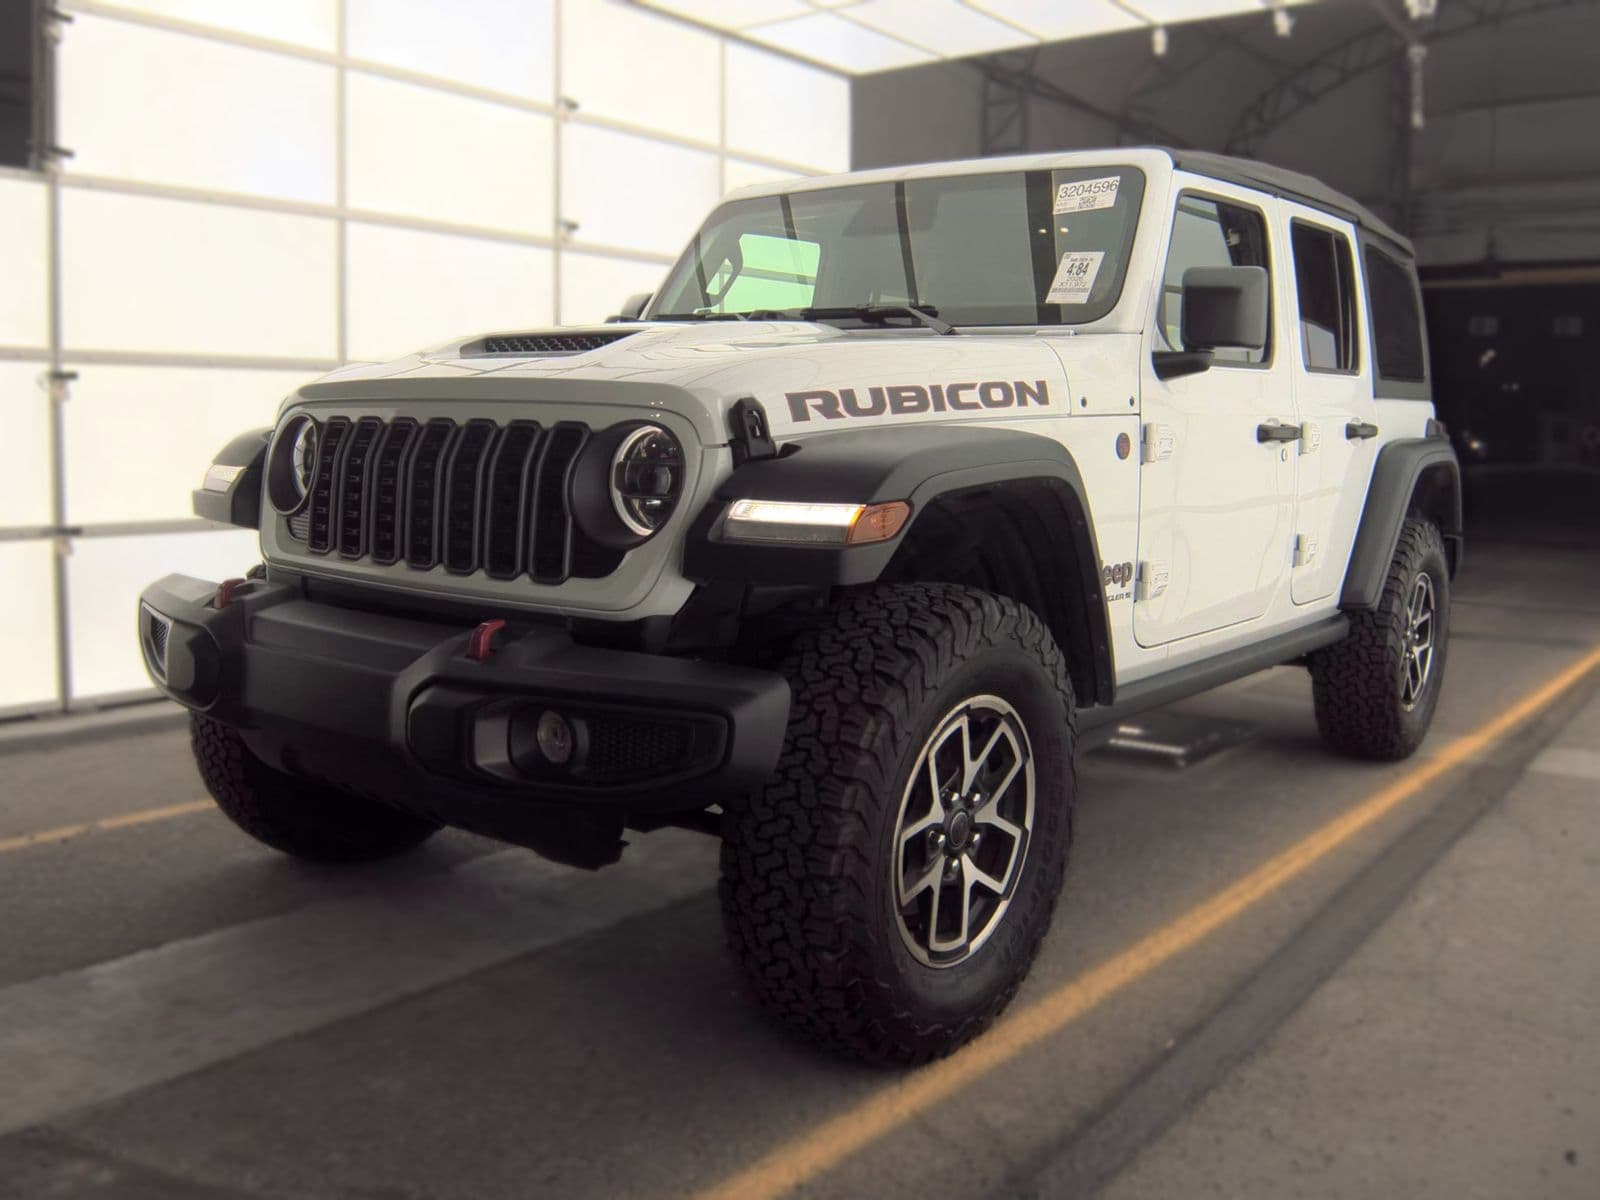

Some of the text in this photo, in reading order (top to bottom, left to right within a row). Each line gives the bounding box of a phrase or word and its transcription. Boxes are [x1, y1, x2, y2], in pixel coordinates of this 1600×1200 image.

[1059, 180, 1119, 199] 3204596
[1067, 262, 1090, 276] 4:84
[784, 380, 1050, 422] RUBICON
[1101, 562, 1133, 588] eep
